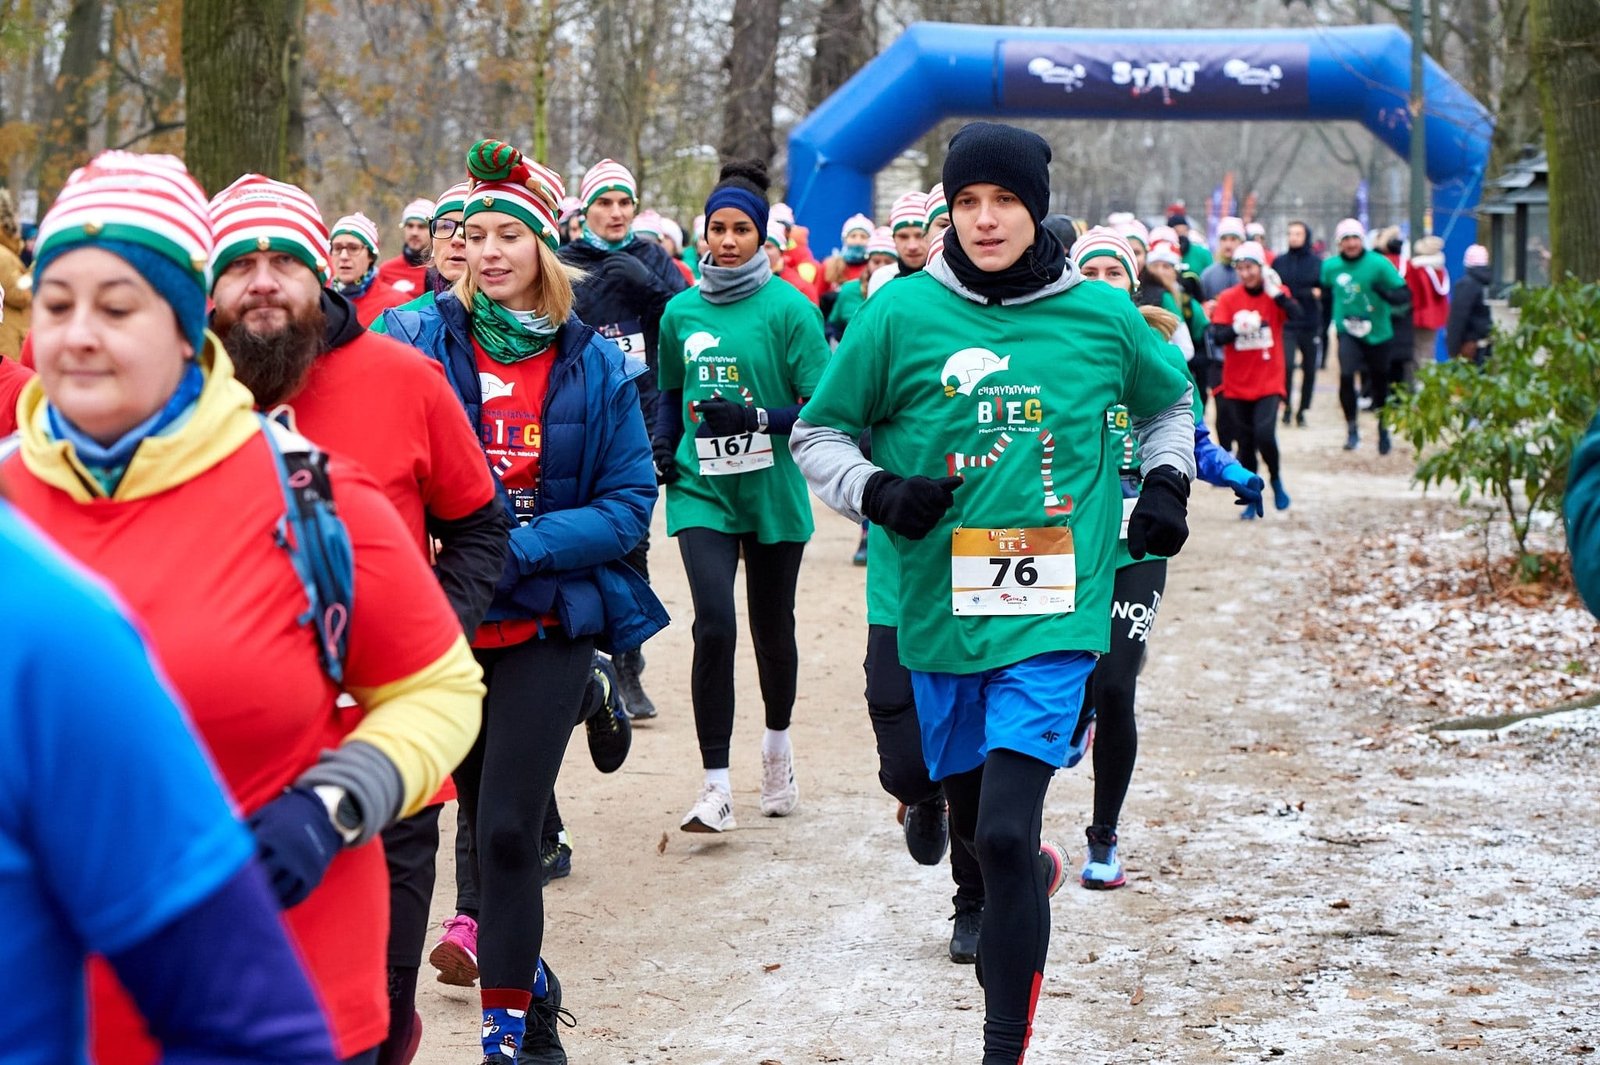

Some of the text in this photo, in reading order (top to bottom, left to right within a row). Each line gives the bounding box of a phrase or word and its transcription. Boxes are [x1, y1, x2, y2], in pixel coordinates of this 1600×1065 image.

[1112, 61, 1200, 93] START
[698, 364, 739, 382] BIEG
[978, 385, 1041, 396] CHARYTATYWNY
[977, 397, 1042, 424] BIEG
[710, 433, 753, 457] 167
[989, 557, 1038, 587] 76
[1111, 601, 1157, 627] NOR
[1041, 730, 1060, 743] 4F
